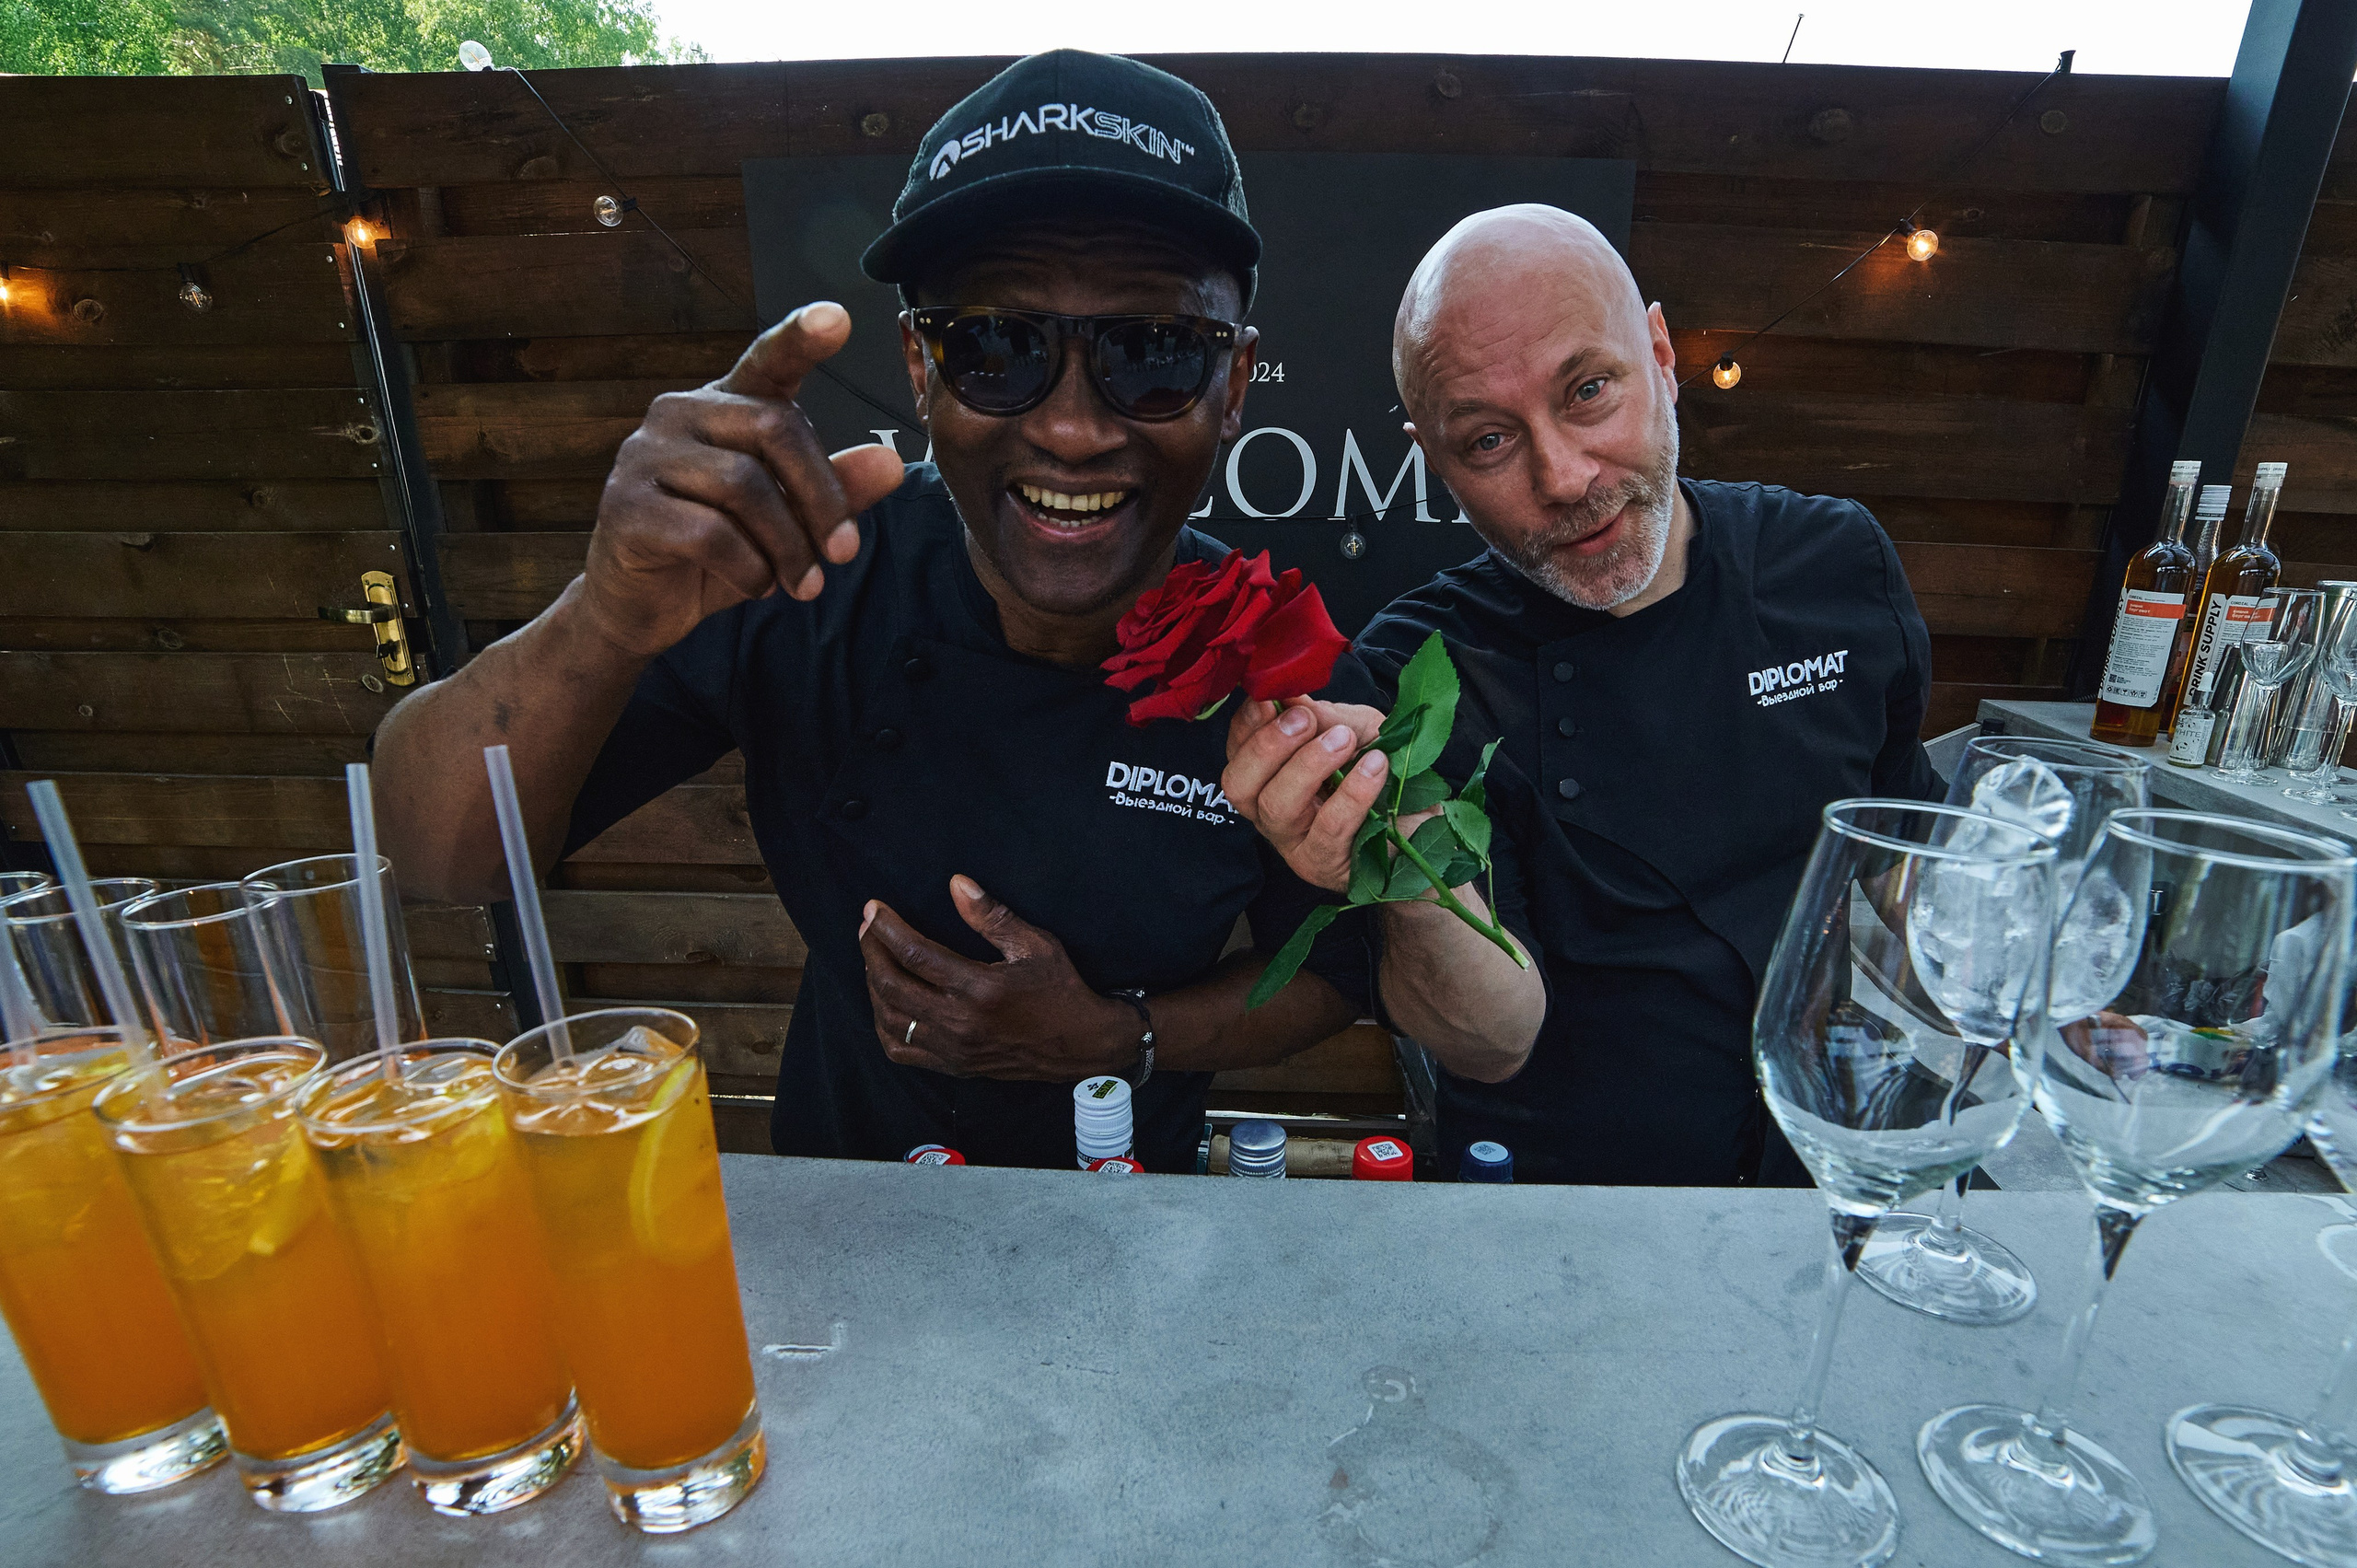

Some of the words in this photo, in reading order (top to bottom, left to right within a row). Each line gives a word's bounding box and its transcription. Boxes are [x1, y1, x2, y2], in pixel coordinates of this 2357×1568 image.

[2200, 599, 2223, 655] SUPPLY
[1747, 649, 1849, 696] DIPLOMAT
[1105, 761, 1239, 815] DIPLOMA
[1095, 1080, 1116, 1098] ESKO
